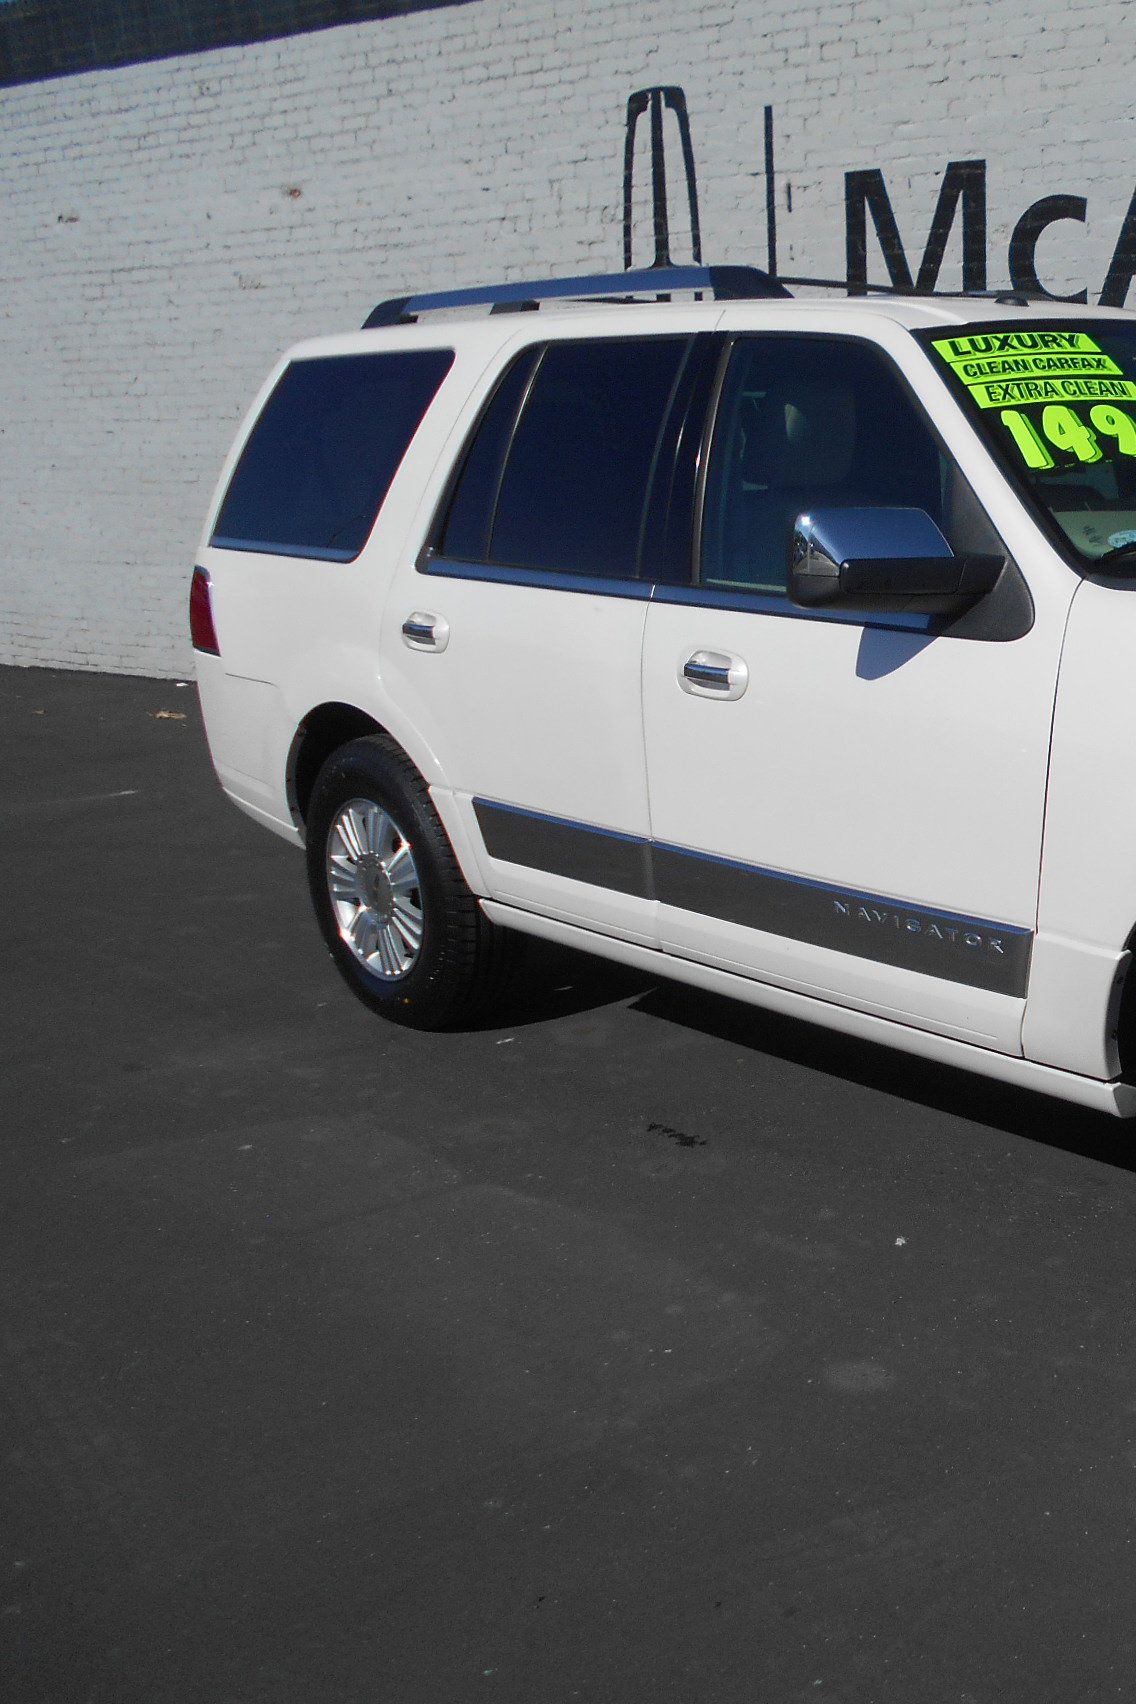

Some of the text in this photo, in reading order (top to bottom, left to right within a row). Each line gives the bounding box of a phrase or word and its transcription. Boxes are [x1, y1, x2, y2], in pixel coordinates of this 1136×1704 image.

[948, 333, 1078, 356] LUXURY
[963, 356, 1107, 378] CLEAN CARFAX
[985, 380, 1129, 403] EXTRA CLEAN
[833, 900, 1004, 954] NAVIGATOR
